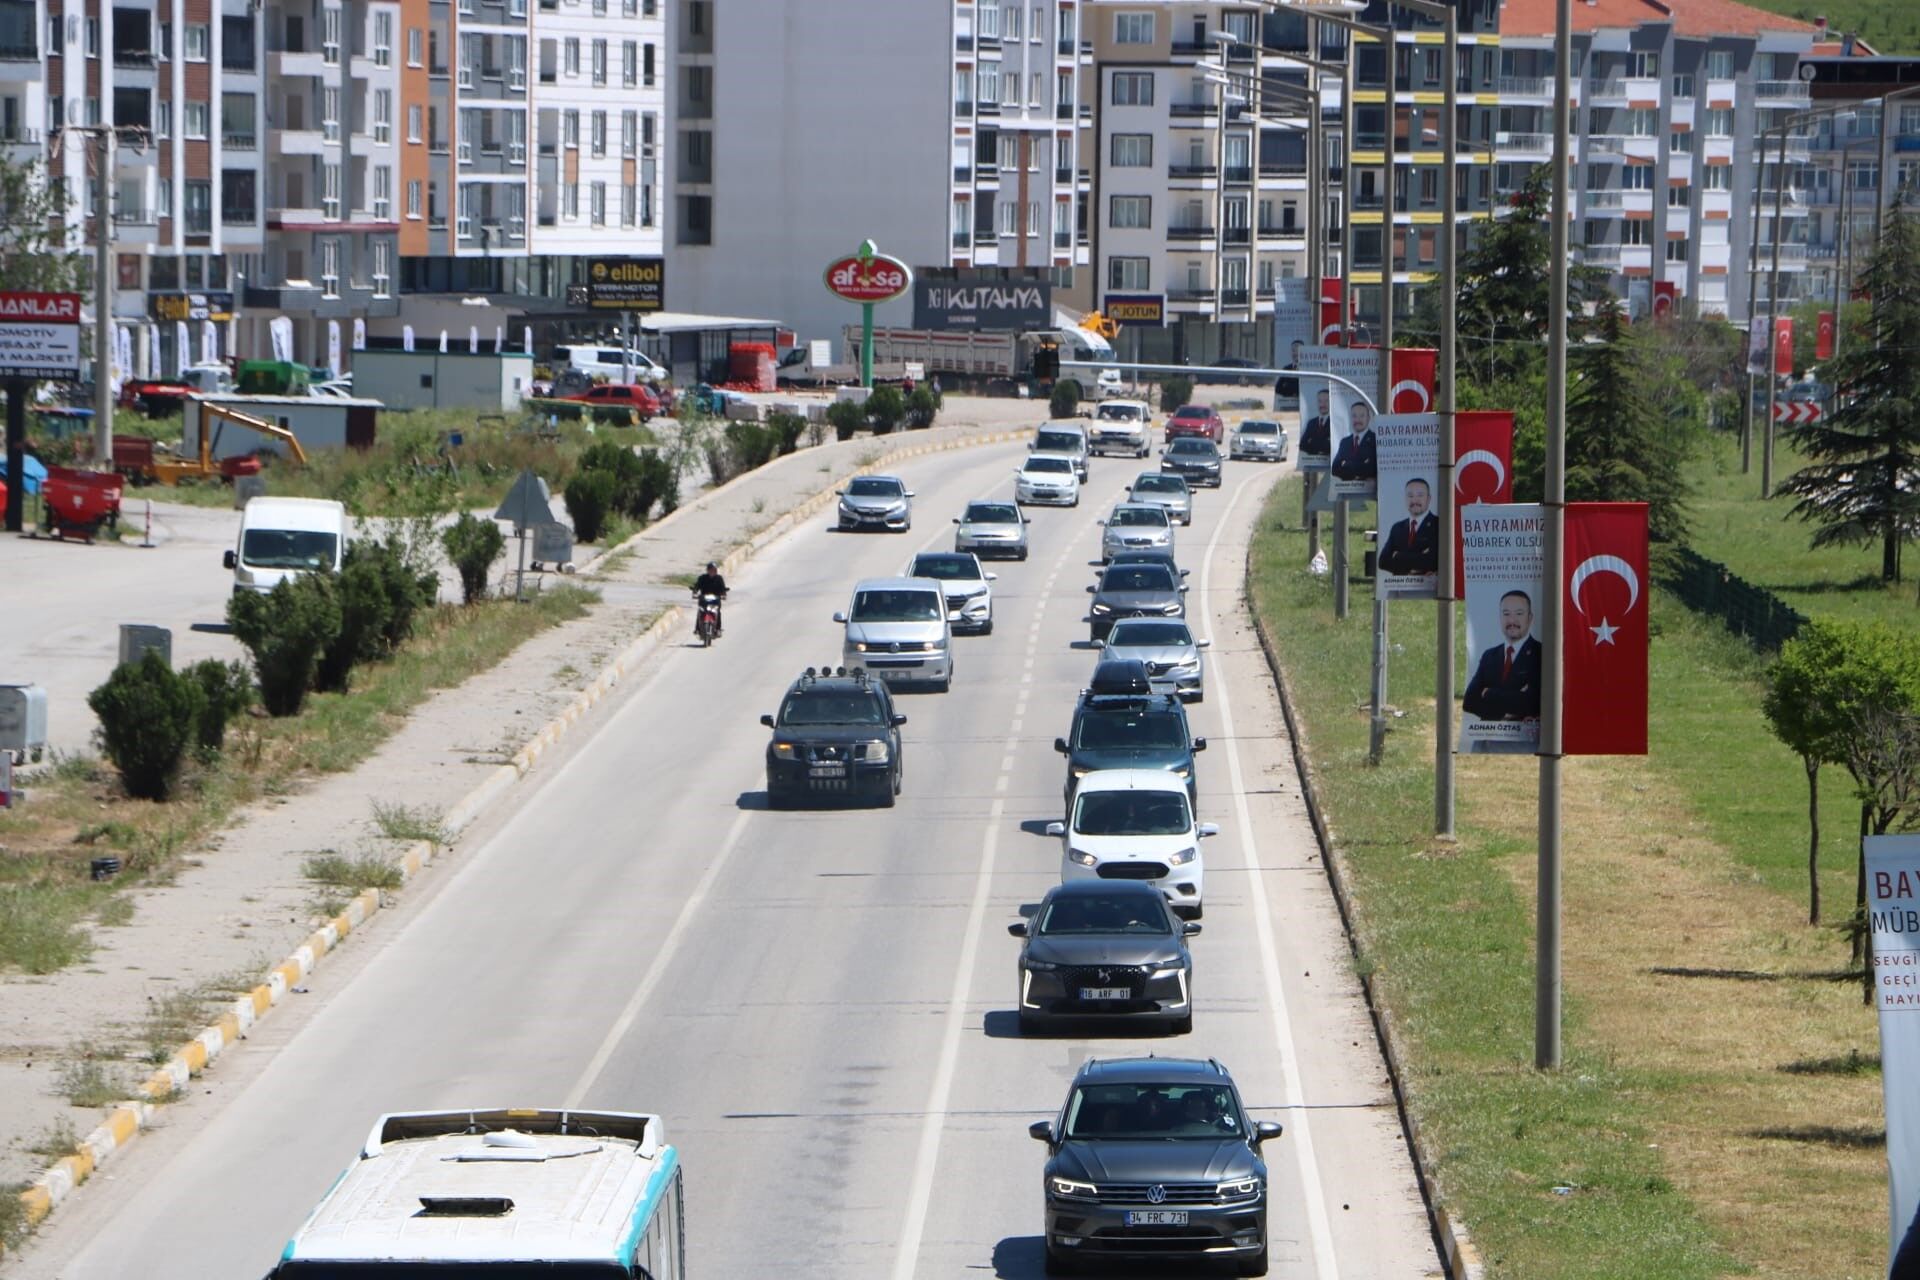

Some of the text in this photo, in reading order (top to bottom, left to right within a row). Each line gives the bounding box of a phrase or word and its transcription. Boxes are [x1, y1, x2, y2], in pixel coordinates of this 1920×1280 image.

[611, 263, 660, 281] elibol
[0, 298, 74, 317] ANLAR
[1122, 306, 1158, 318] JOTUN
[9, 353, 74, 363] MARKET
[1462, 536, 1512, 548] MÜBAREK
[1497, 723, 1521, 732] ÖZTAŞ
[1874, 952, 1917, 967] SEVGİ
[1131, 1213, 1187, 1223] 34 FRC 731
